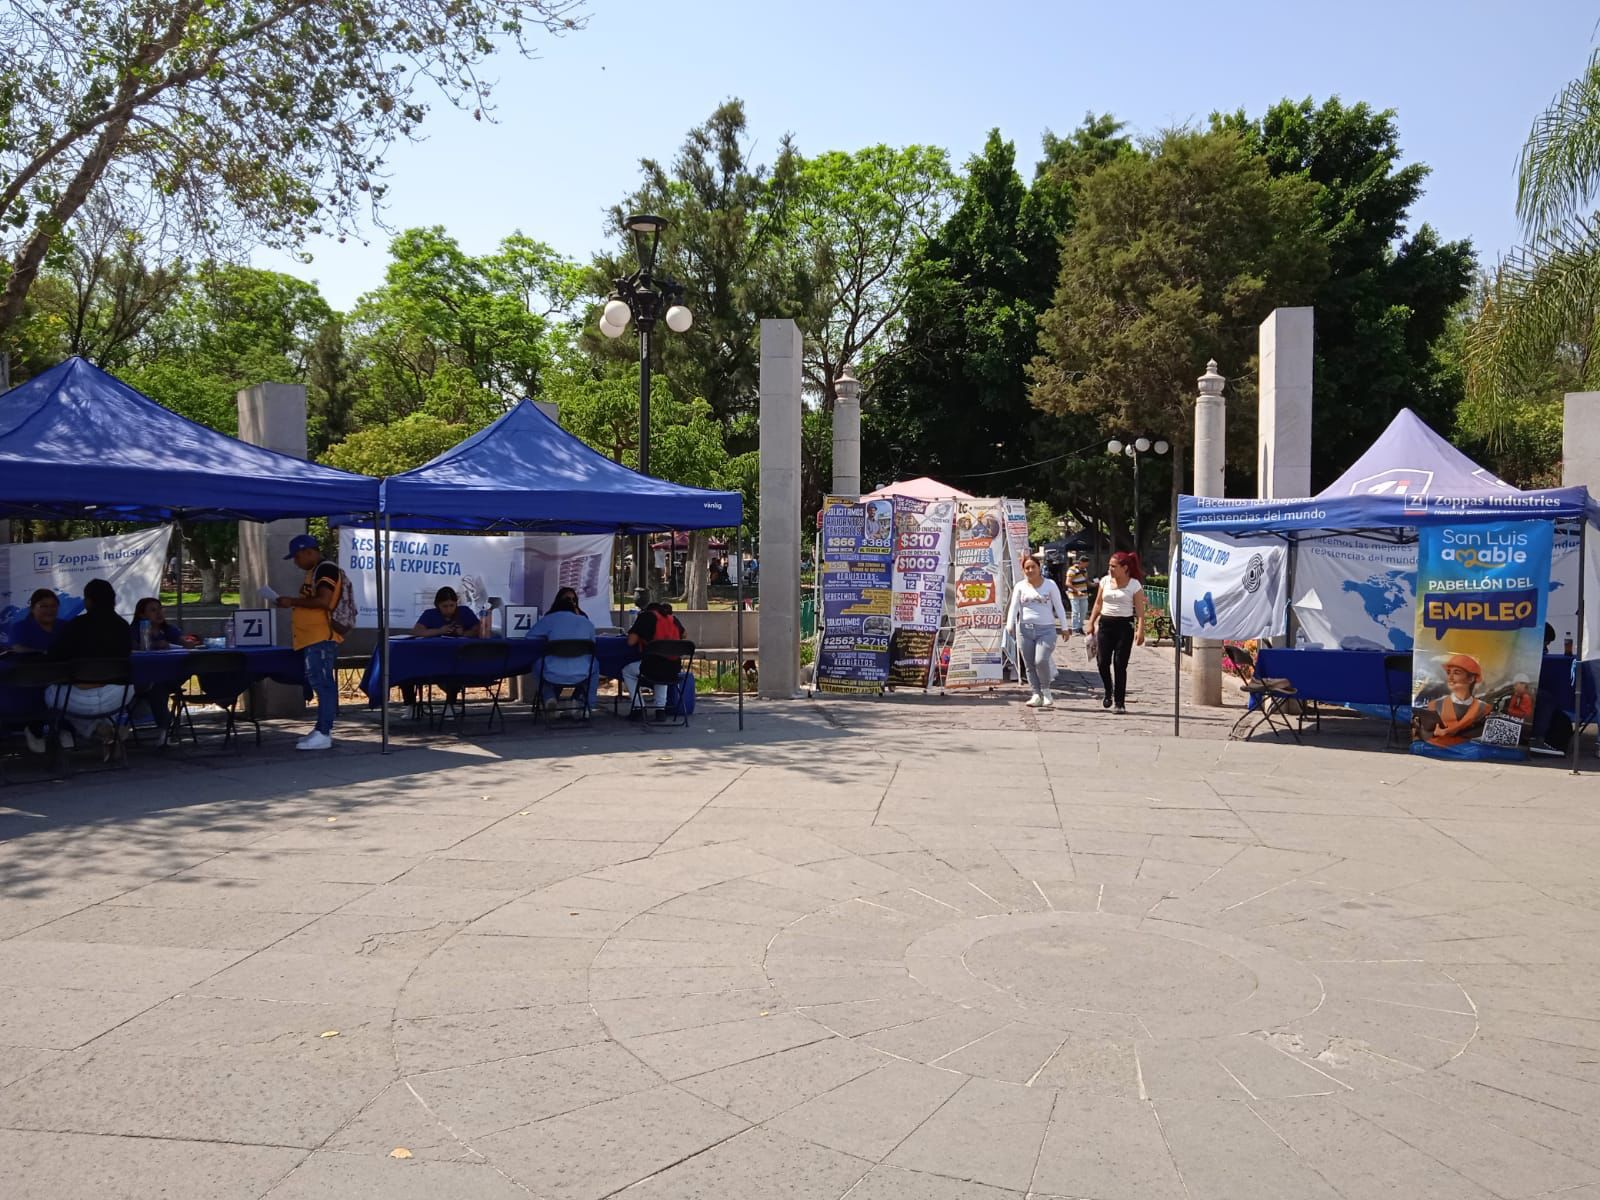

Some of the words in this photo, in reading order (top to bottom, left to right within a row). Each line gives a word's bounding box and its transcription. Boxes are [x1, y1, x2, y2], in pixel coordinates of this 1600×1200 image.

[1197, 498, 1247, 508] Hacemos
[1434, 496, 1484, 510] Zoppas
[1489, 495, 1560, 507] Industries
[1197, 512, 1260, 523] resistencias
[1263, 510, 1281, 521] del
[1284, 508, 1326, 520] mundo
[828, 537, 856, 547] $366
[861, 538, 891, 547] $388
[901, 533, 935, 548] $310
[1442, 529, 1481, 544] San
[1487, 531, 1528, 546] Luis
[433, 544, 450, 557] DE
[38, 556, 49, 567] Zi
[58, 553, 100, 566] Zoppas
[899, 557, 936, 571] $1000
[400, 559, 461, 576] EXPUESTA
[907, 581, 915, 589] 12
[925, 581, 941, 591] 7%
[1428, 576, 1502, 591] PABELLÓN
[1506, 577, 1534, 589] DEL
[921, 599, 941, 607] 25%
[1428, 601, 1533, 621] EMPLEO
[514, 614, 531, 630] Zi
[925, 615, 937, 624] 15
[243, 619, 263, 637] Zi
[824, 637, 855, 645] $2562
[857, 638, 888, 646] $2716
